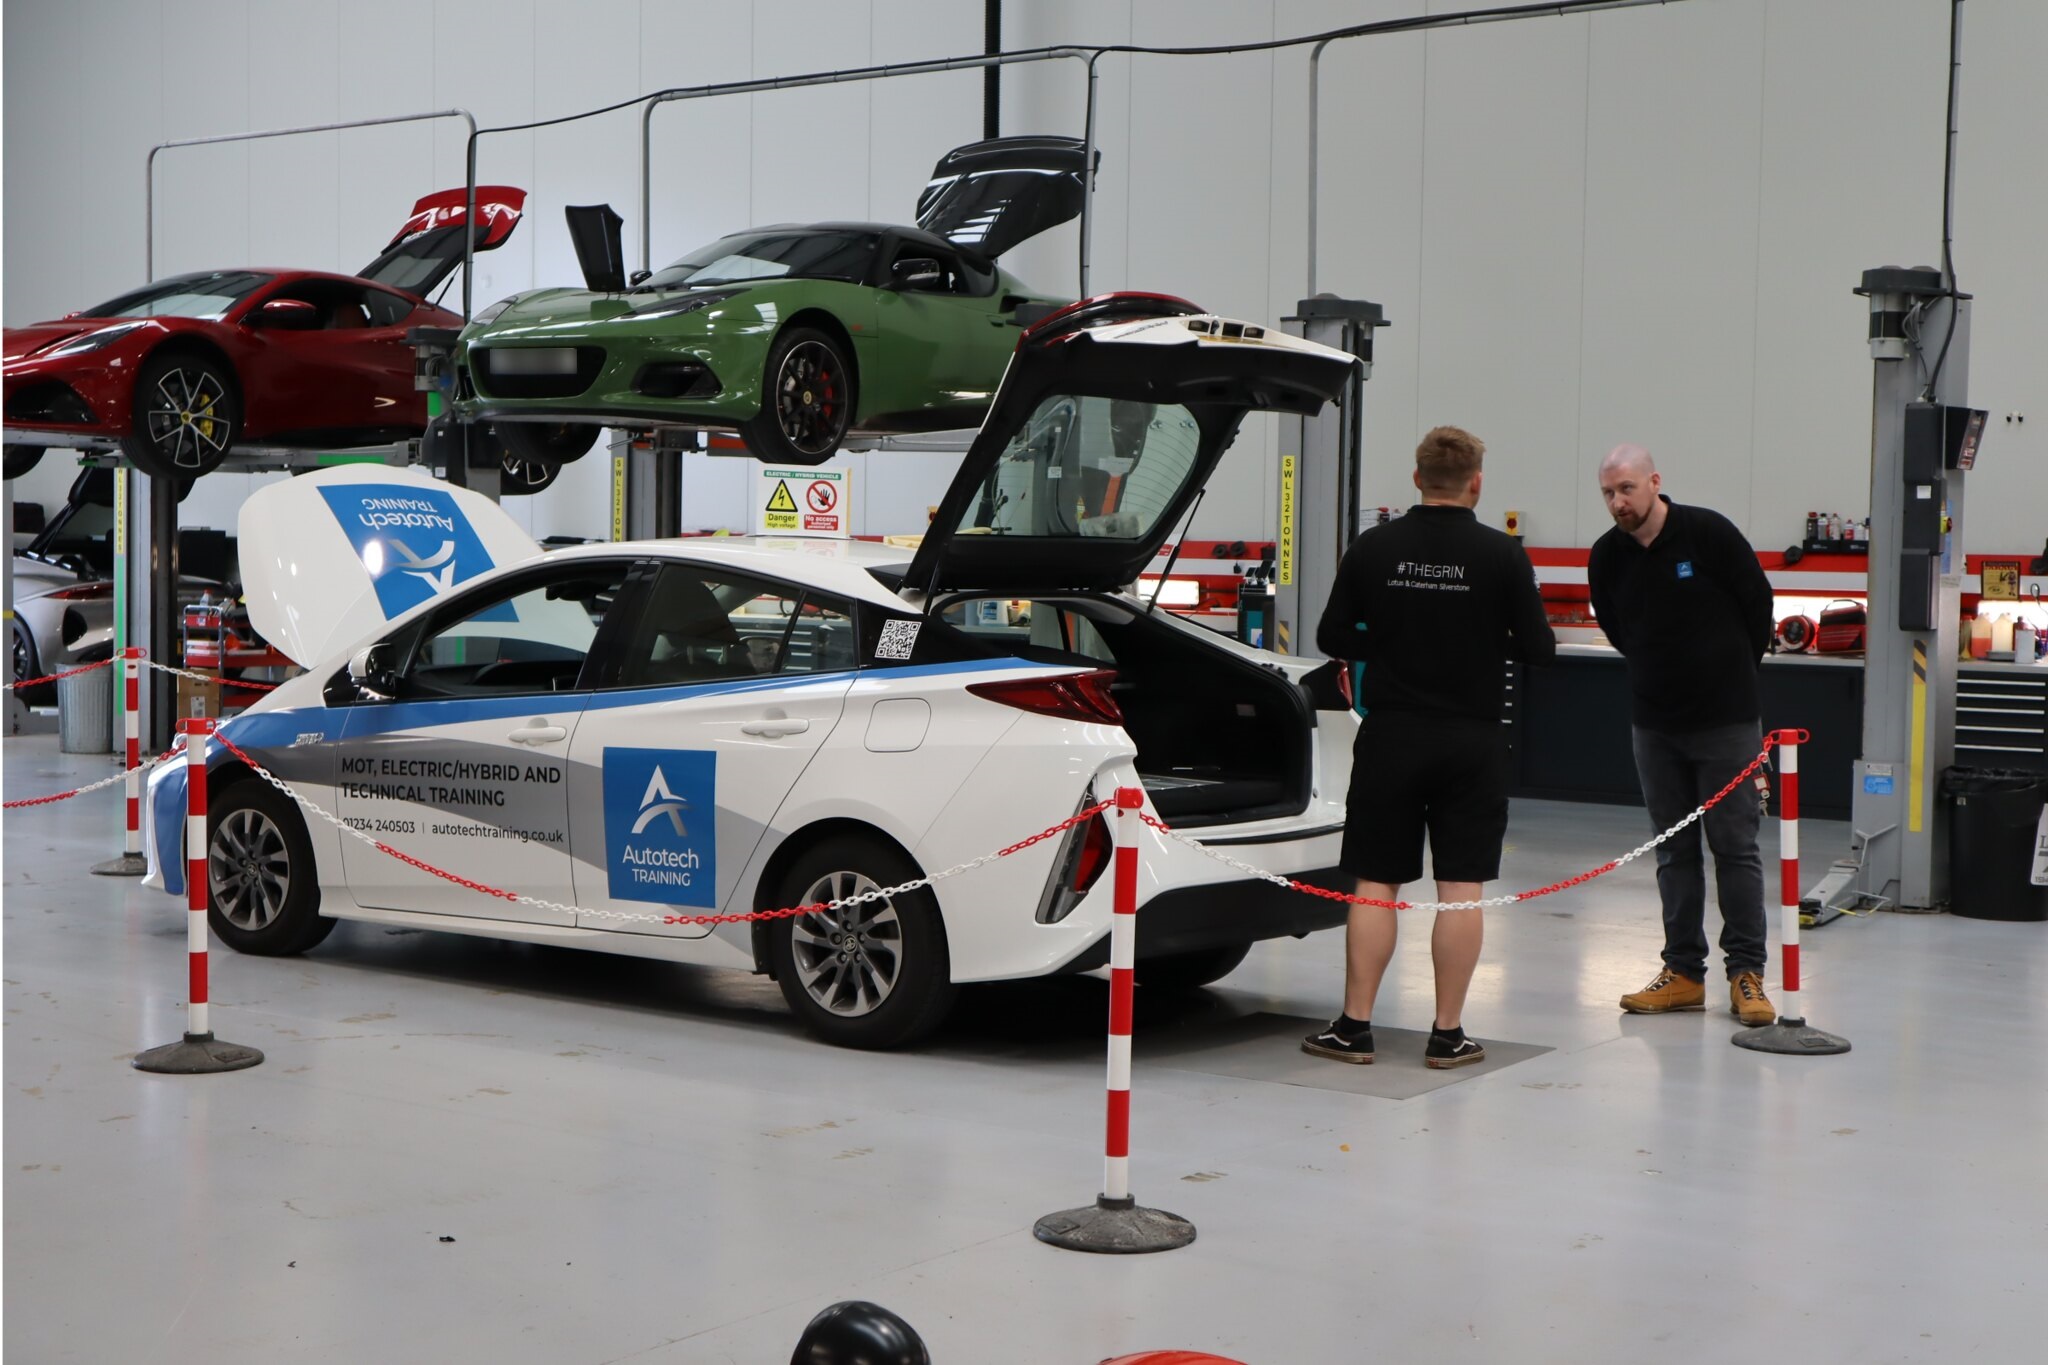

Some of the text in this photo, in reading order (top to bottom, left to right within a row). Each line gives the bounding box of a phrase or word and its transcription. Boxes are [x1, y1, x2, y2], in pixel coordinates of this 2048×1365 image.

[361, 499, 438, 512] TRAINING
[358, 513, 454, 532] Autotech
[768, 513, 795, 522] Danger
[1397, 562, 1464, 579] #THEGRIN
[1411, 581, 1437, 589] Caterham
[1439, 583, 1470, 592] Silverstone
[341, 757, 561, 784] MOT, ELECTRIC/HYBRID AND
[341, 783, 504, 807] TECHNICAL TRAINING
[375, 819, 416, 834] 240503
[432, 823, 563, 843] autotechtraining.co.uk
[622, 845, 699, 869] Autotech
[631, 868, 691, 887] TRAINING
